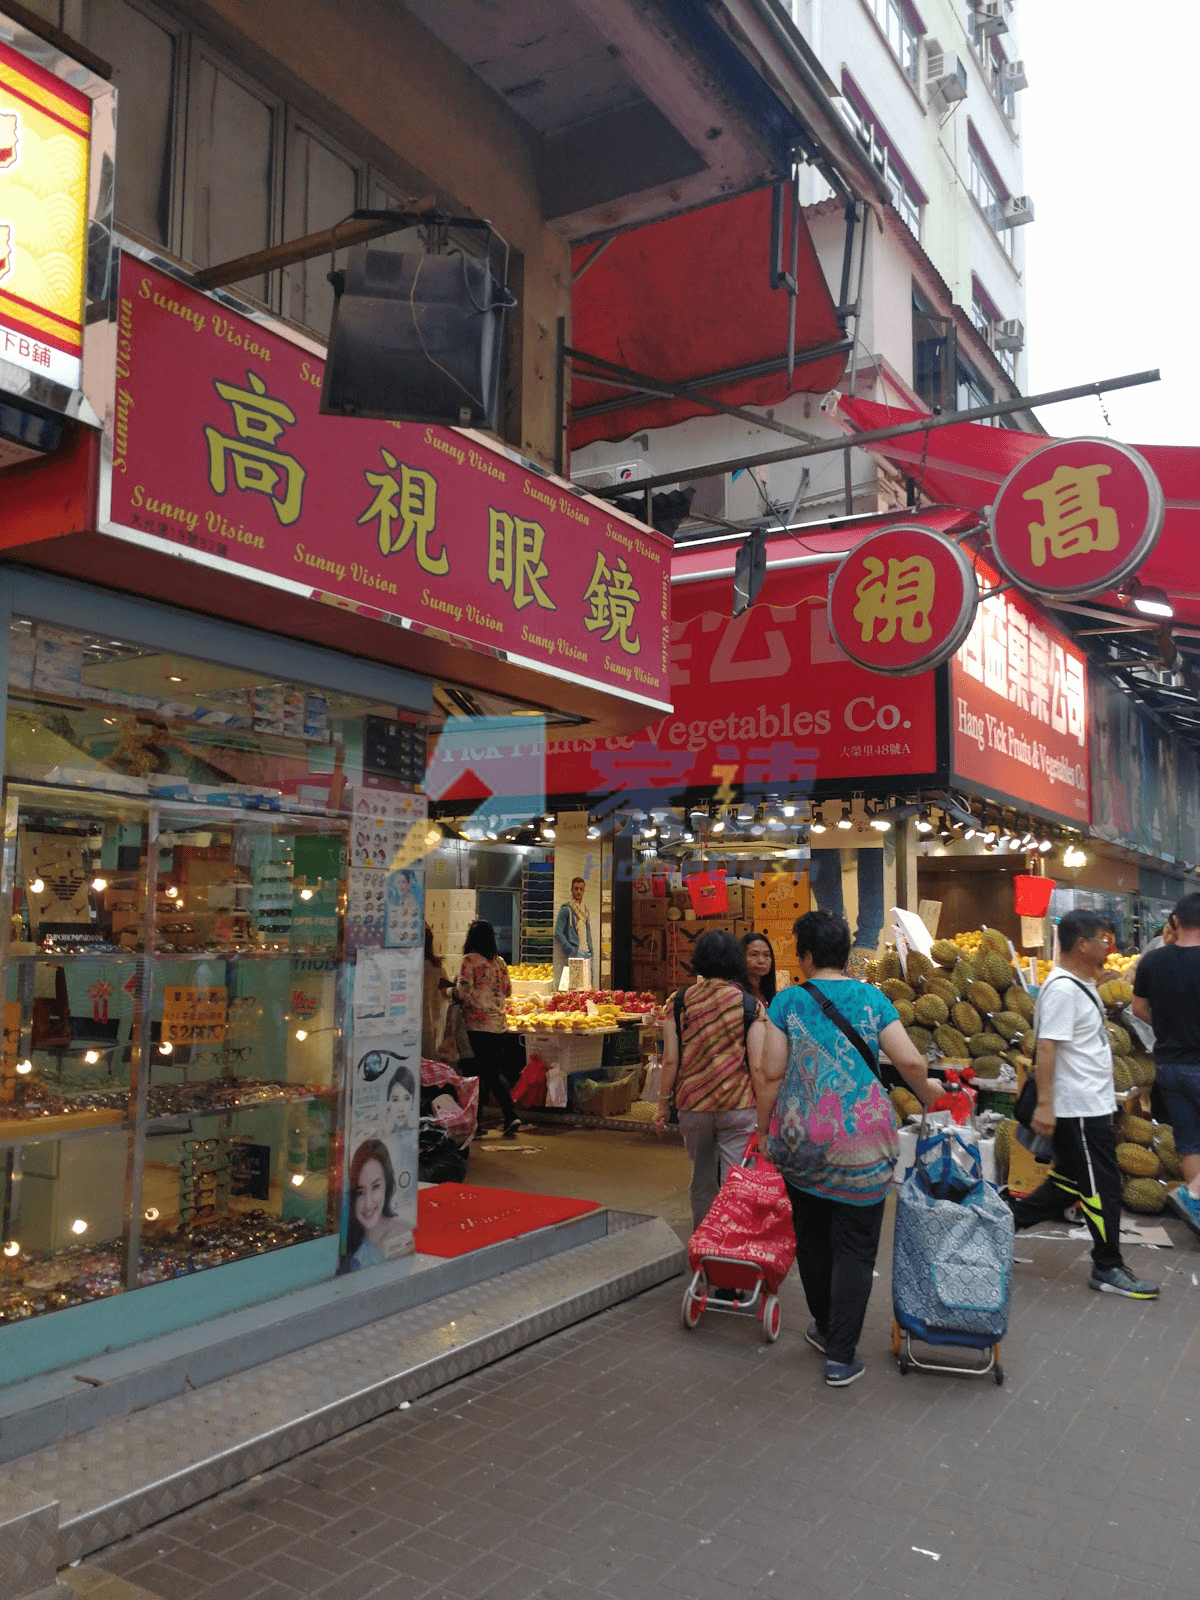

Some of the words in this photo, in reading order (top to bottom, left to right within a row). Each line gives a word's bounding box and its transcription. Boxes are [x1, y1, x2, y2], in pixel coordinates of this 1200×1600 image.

[115, 298, 132, 379] Vision
[137, 277, 205, 333] Sunny
[212, 314, 272, 362] Vision
[112, 384, 134, 474] Sunny
[424, 428, 466, 465] Sunny
[469, 448, 505, 482] Vision
[130, 485, 199, 532] Sunny
[205, 510, 265, 549] Vision
[202, 369, 642, 657] 高視眼鏡
[523, 479, 557, 512] Sunny
[559, 496, 590, 526] Vision
[293, 543, 347, 582] Sunny
[350, 562, 398, 595] Vision
[605, 522, 634, 552] Sunny
[635, 539, 661, 563] Vision
[420, 588, 463, 622] Sunny
[466, 604, 504, 633] Vision
[660, 570, 670, 621] Sunny
[521, 625, 554, 650] Sunny
[557, 638, 588, 663] Vision
[660, 624, 670, 674] Vision
[603, 655, 633, 682] Sunny
[634, 666, 660, 688] Vision
[644, 702, 832, 751] Vegetables
[843, 696, 911, 732] Co.
[957, 696, 985, 751] Hang
[985, 713, 1007, 755] Yick
[1007, 725, 1031, 767] Fruits
